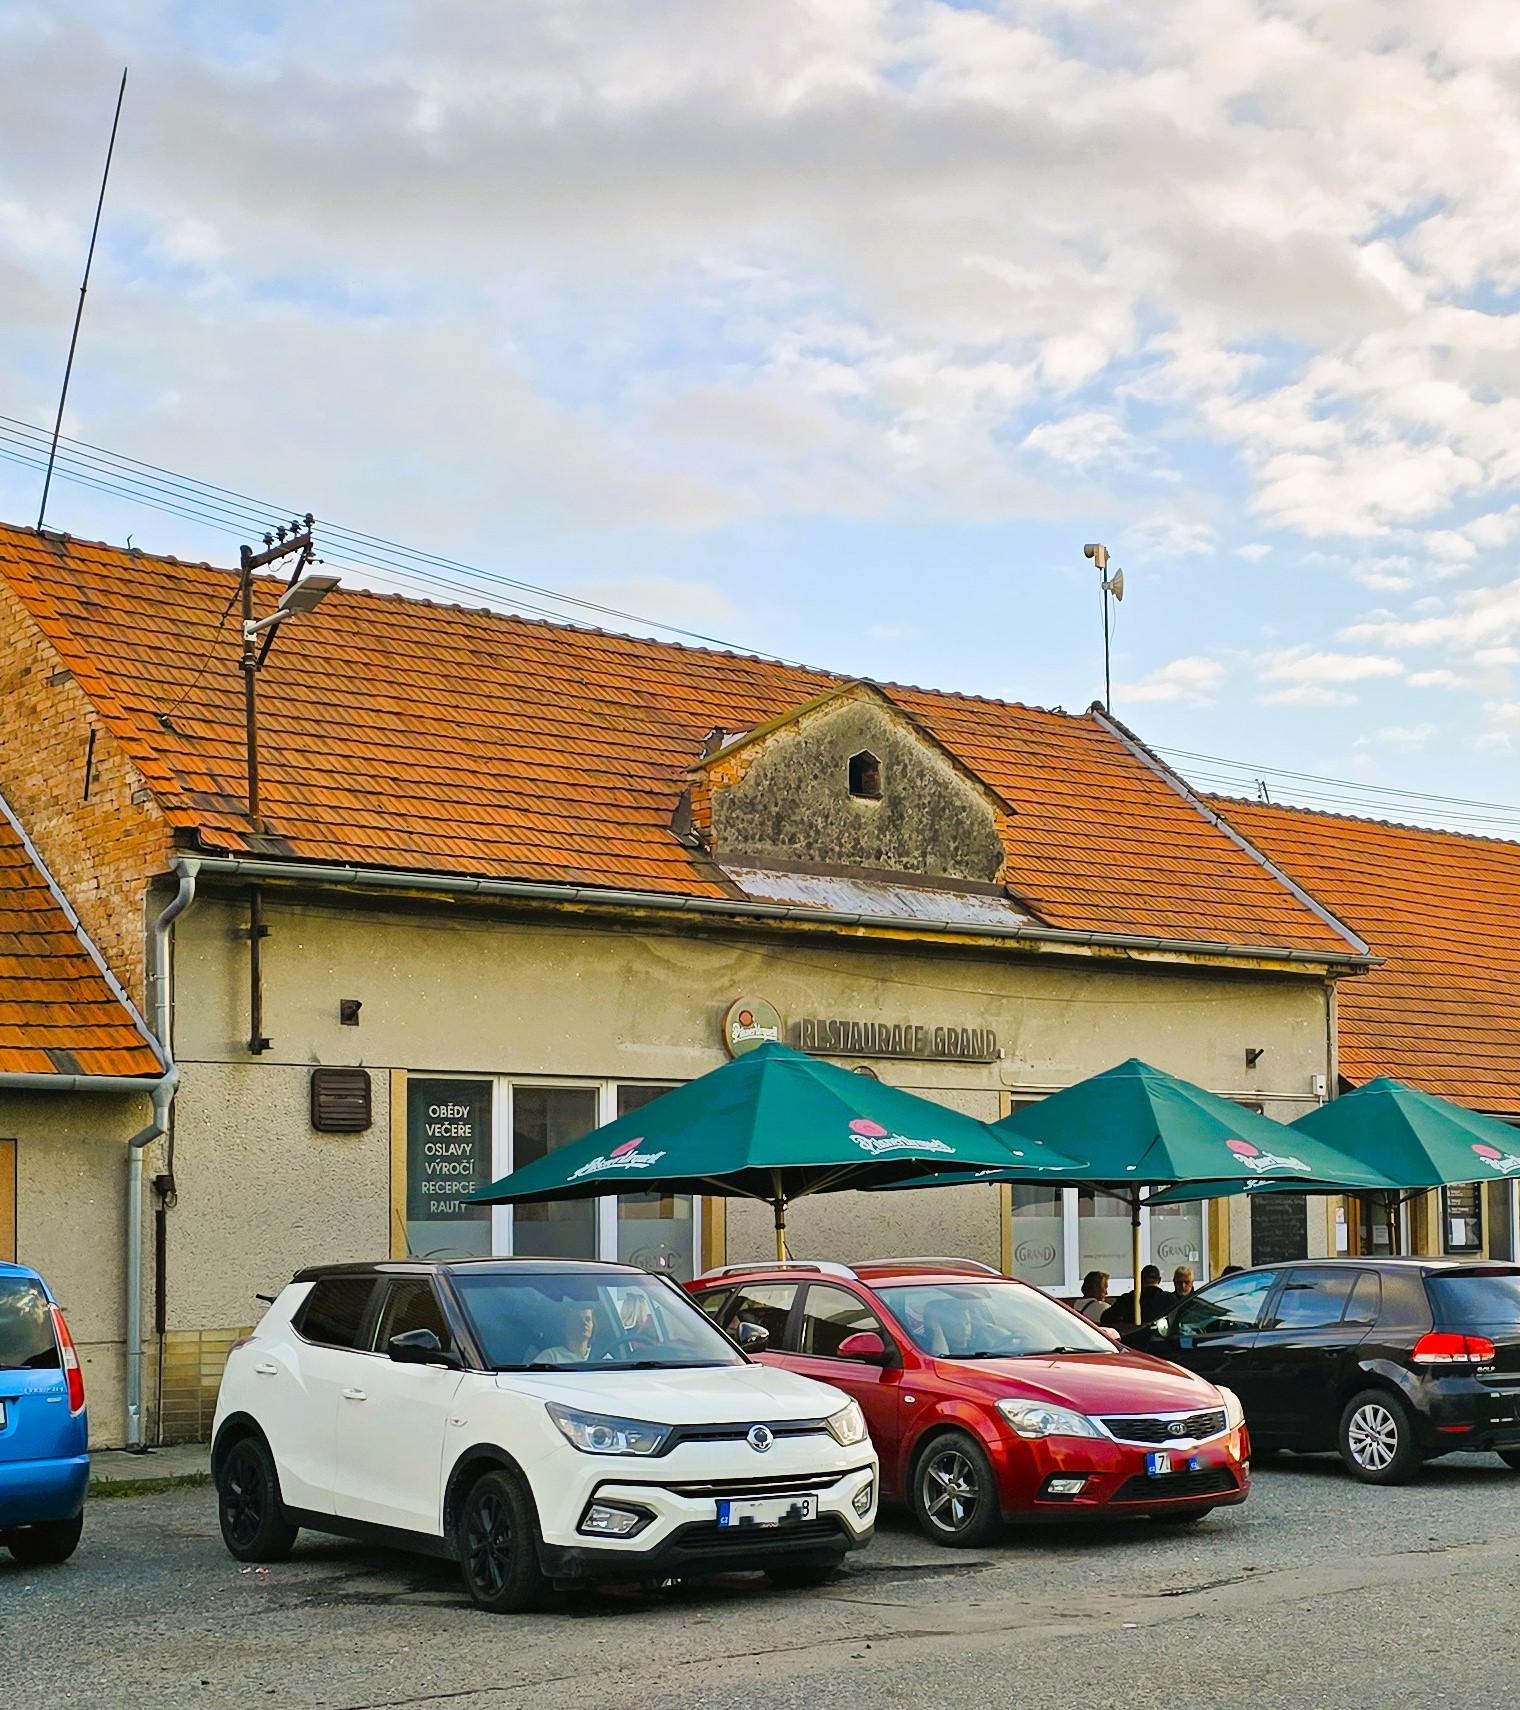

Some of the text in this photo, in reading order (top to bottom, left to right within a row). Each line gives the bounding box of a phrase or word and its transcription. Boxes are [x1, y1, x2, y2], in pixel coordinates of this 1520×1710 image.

[801, 1018, 997, 1056] RESTAURACE GRAND
[428, 1102, 470, 1119] OBĚDY
[425, 1121, 472, 1137] VEČEŘE
[424, 1143, 473, 1156] OSLAVY
[424, 1158, 475, 1175] VÝROČÍ
[421, 1181, 476, 1194] RECEPCE
[430, 1200, 467, 1213] RAUTY
